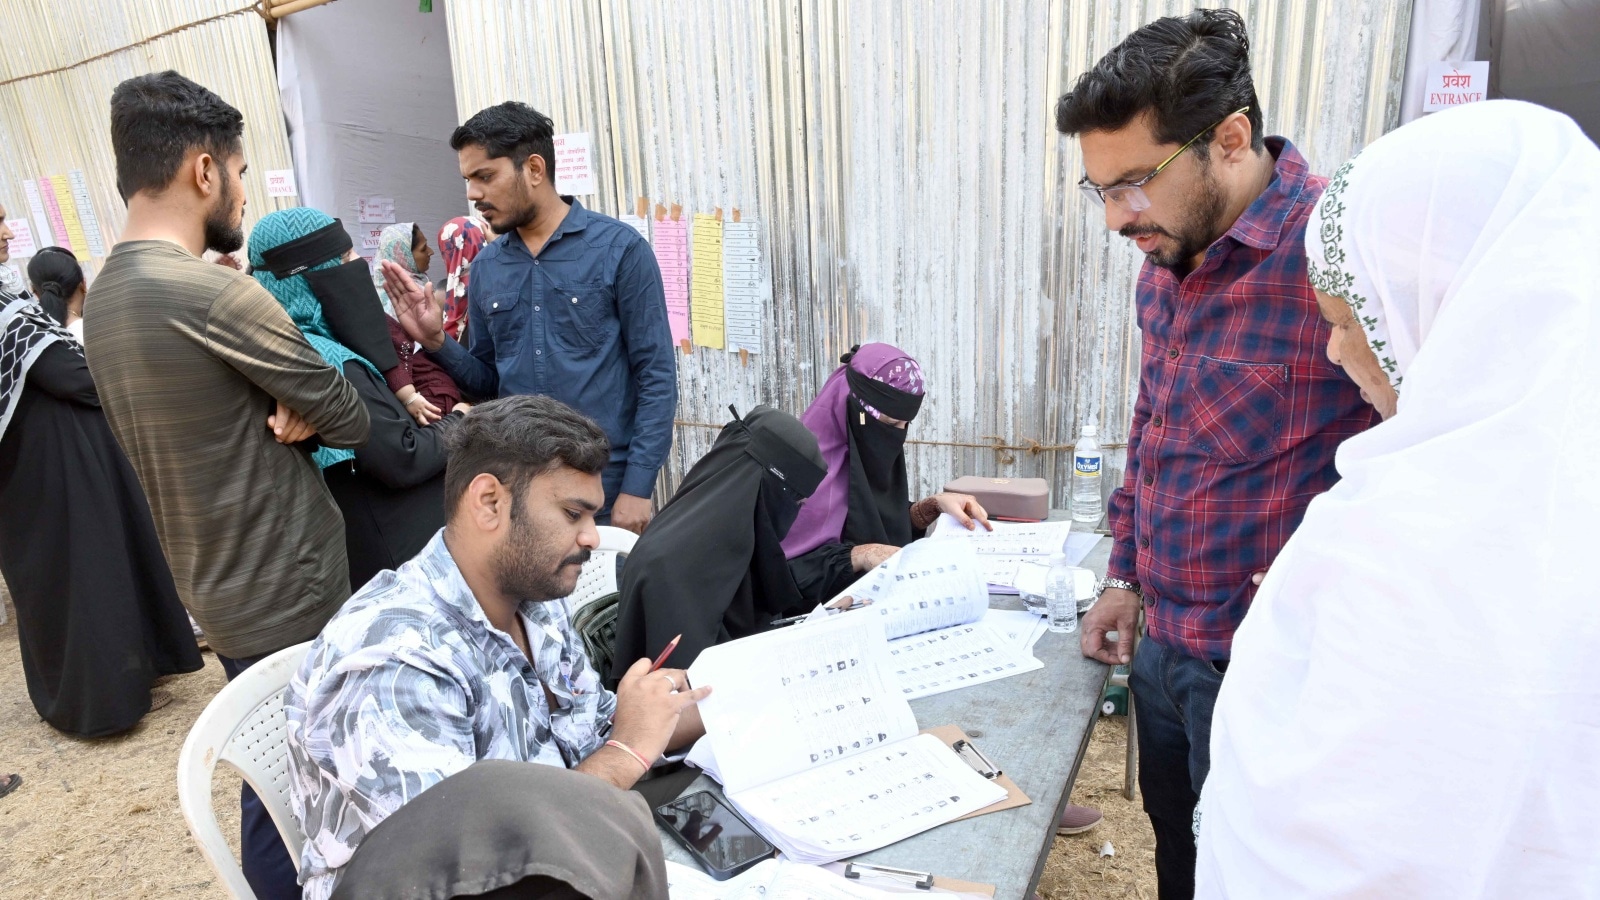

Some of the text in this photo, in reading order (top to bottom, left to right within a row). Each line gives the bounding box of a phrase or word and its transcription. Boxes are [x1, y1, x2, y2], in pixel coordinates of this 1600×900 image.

[1442, 69, 1471, 89] प्रवेश
[1430, 93, 1482, 104] ENTRANCE
[370, 226, 382, 237] प्रवे
